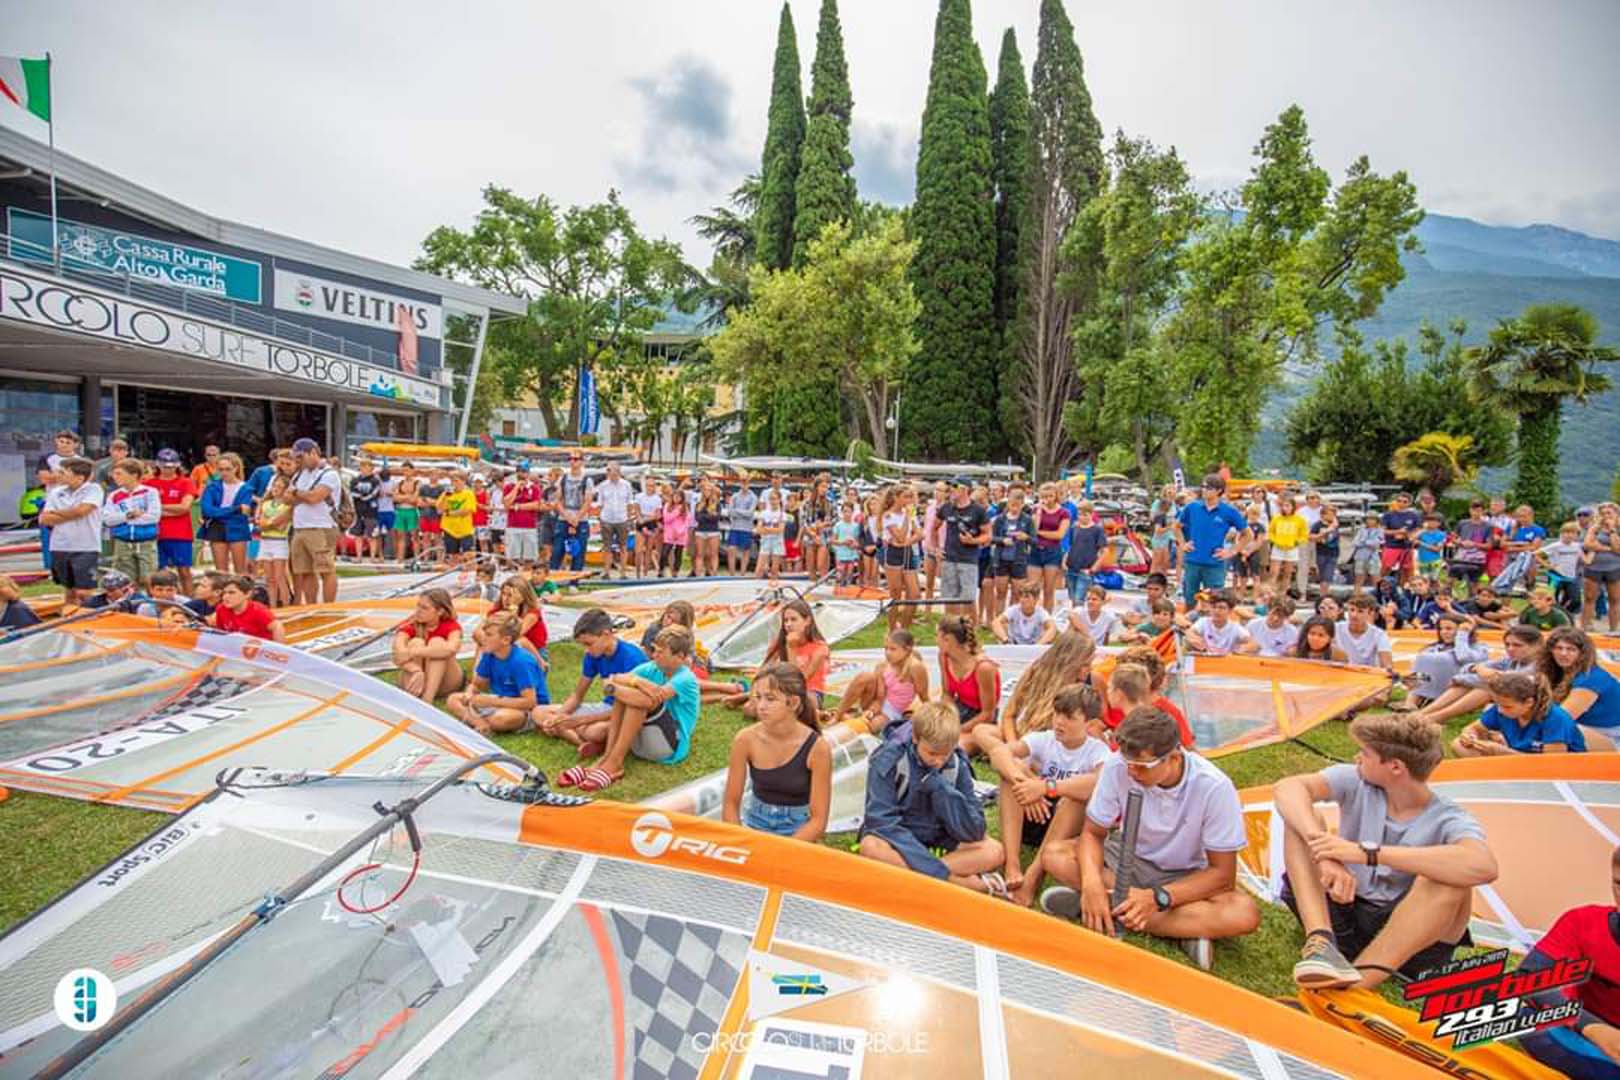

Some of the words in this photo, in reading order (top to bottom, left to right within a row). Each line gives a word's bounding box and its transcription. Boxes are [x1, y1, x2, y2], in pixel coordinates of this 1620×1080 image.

[112, 256, 158, 278] Alto
[171, 267, 227, 291] Garda
[113, 236, 170, 263] Cassa
[173, 248, 227, 274] Rurale
[182, 322, 258, 363] SURF
[263, 341, 371, 389] TORBOLE
[26, 705, 248, 773] ITA-20
[148, 828, 185, 855] BIC
